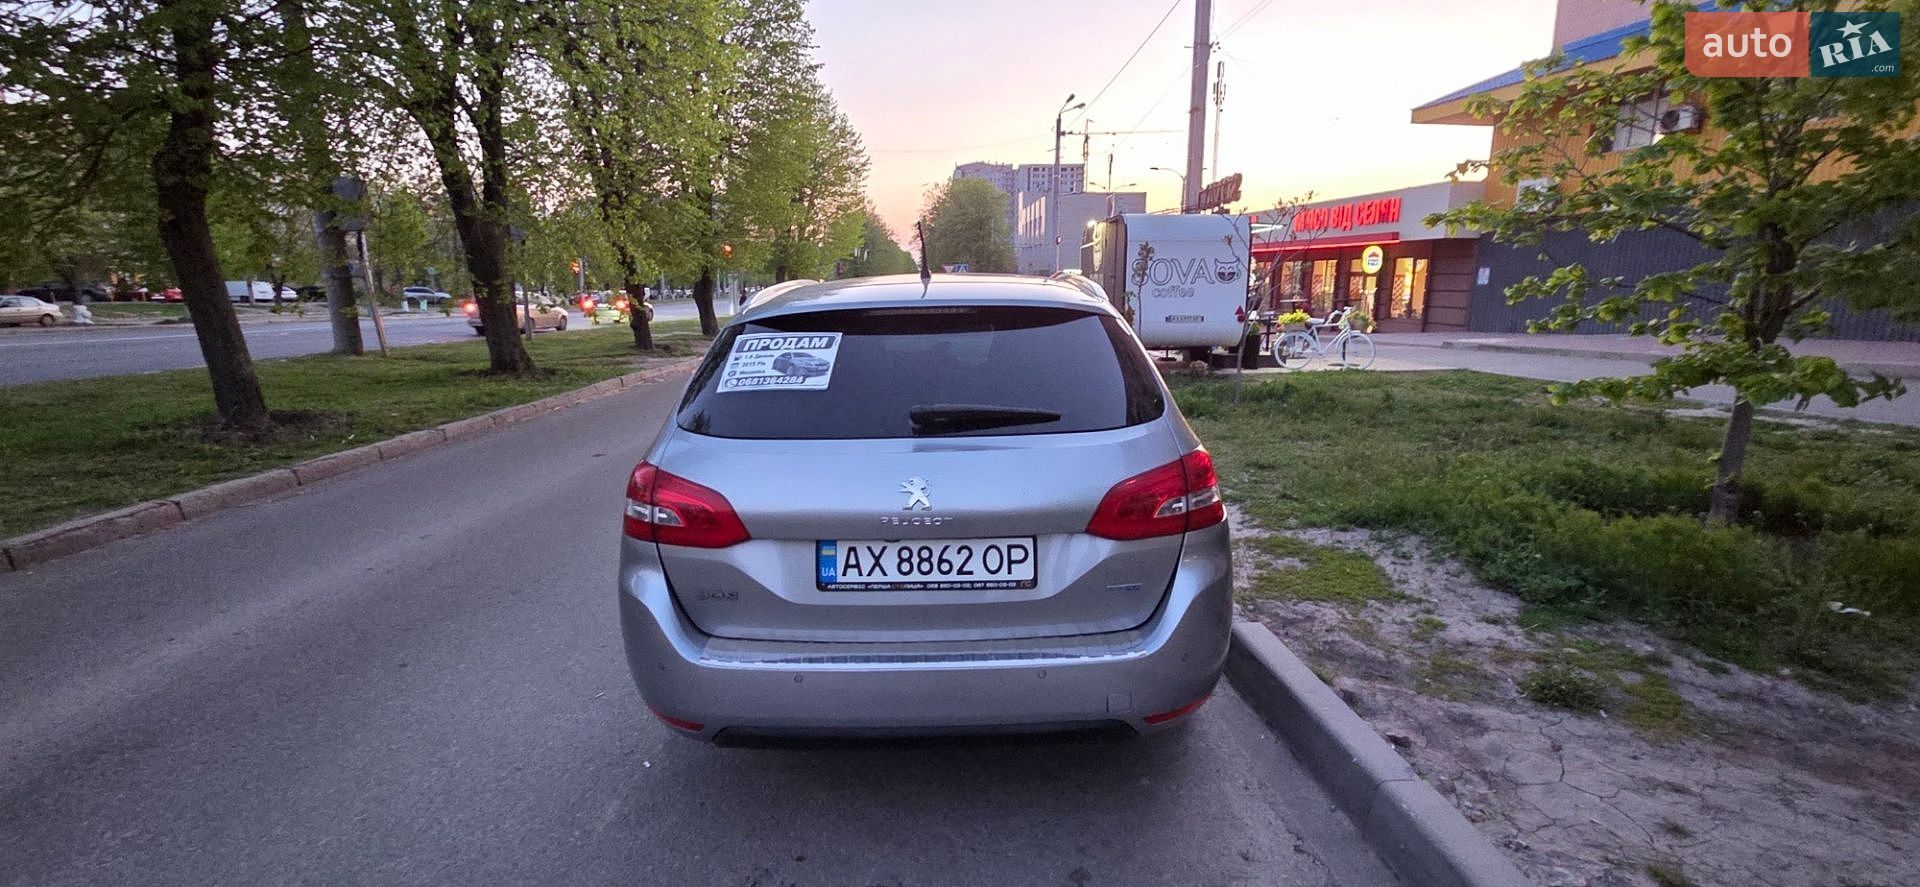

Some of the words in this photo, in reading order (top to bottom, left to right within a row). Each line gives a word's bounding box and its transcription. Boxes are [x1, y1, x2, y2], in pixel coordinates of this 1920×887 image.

[1329, 203, 1354, 231] ВІД
[1131, 258, 1215, 286] SOVA
[1151, 285, 1195, 298] coffee
[743, 337, 829, 351] ПРОДАМ
[841, 546, 888, 577] AX
[896, 545, 974, 576] 8862
[982, 543, 1030, 575] OP
[821, 567, 836, 577] UA
